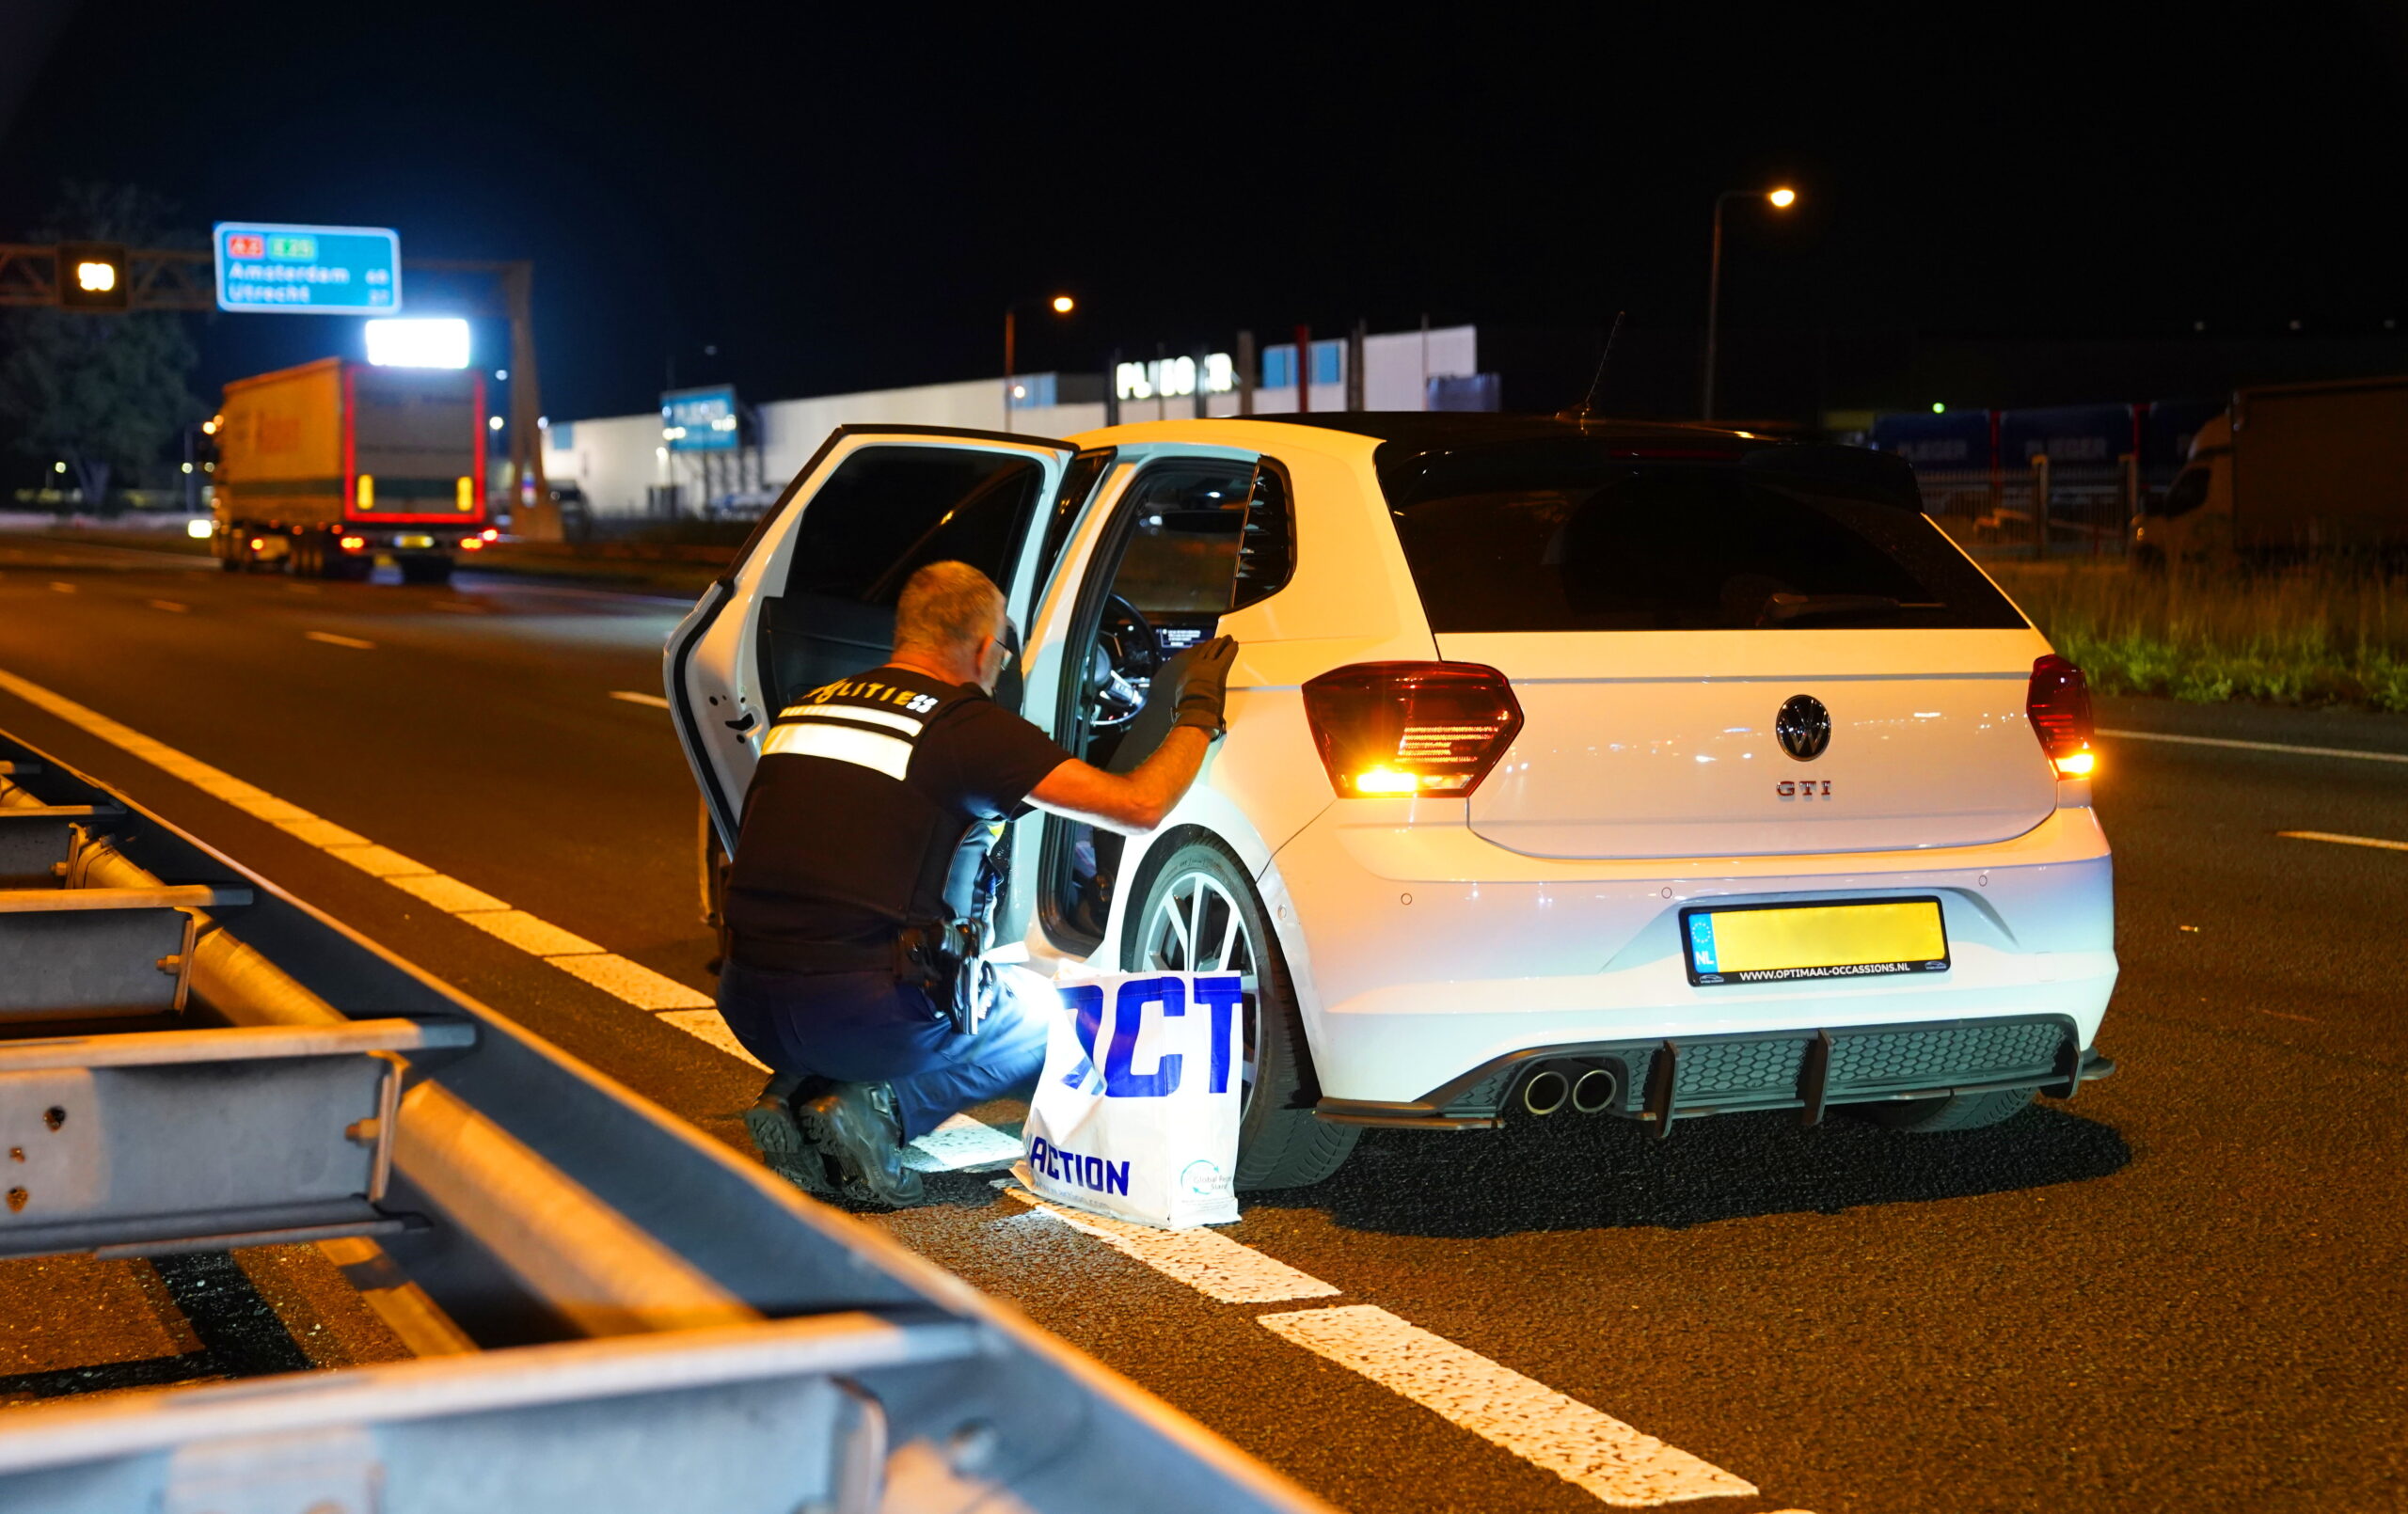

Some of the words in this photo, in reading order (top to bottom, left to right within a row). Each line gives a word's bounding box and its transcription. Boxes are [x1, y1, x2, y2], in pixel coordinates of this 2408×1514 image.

[229, 262, 351, 285] Amsterdam
[229, 284, 310, 304] Utrecht
[1776, 780, 1831, 796] GTI
[1694, 951, 1715, 966] NL
[1739, 962, 1911, 981] WWW.OPTIMAAL-OCCASSIONS.NL
[1030, 1136, 1131, 1197] ACTION
